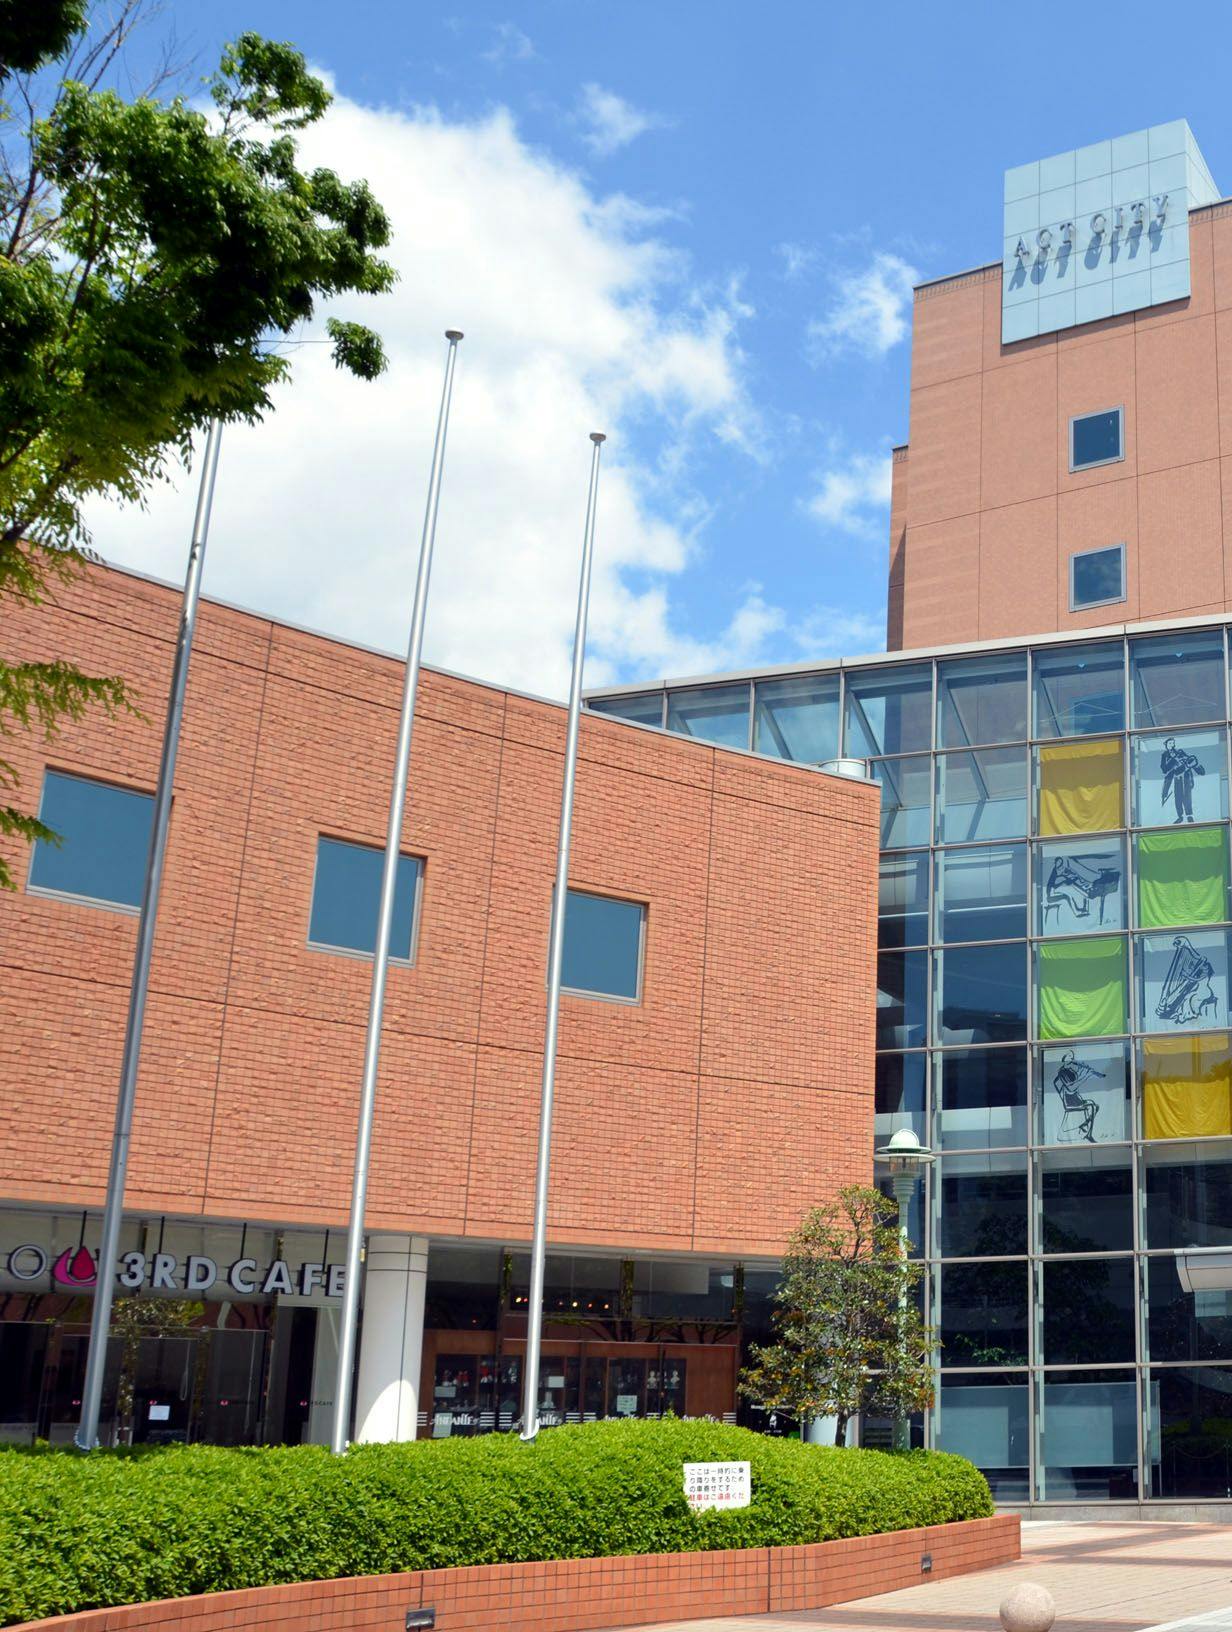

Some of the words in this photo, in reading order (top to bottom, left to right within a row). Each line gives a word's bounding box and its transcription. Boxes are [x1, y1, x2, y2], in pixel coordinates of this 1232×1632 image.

[1014, 222, 1076, 258] ACT
[1090, 193, 1169, 234] CITY
[120, 1251, 217, 1290] 3RD
[230, 1258, 346, 1298] CAFE
